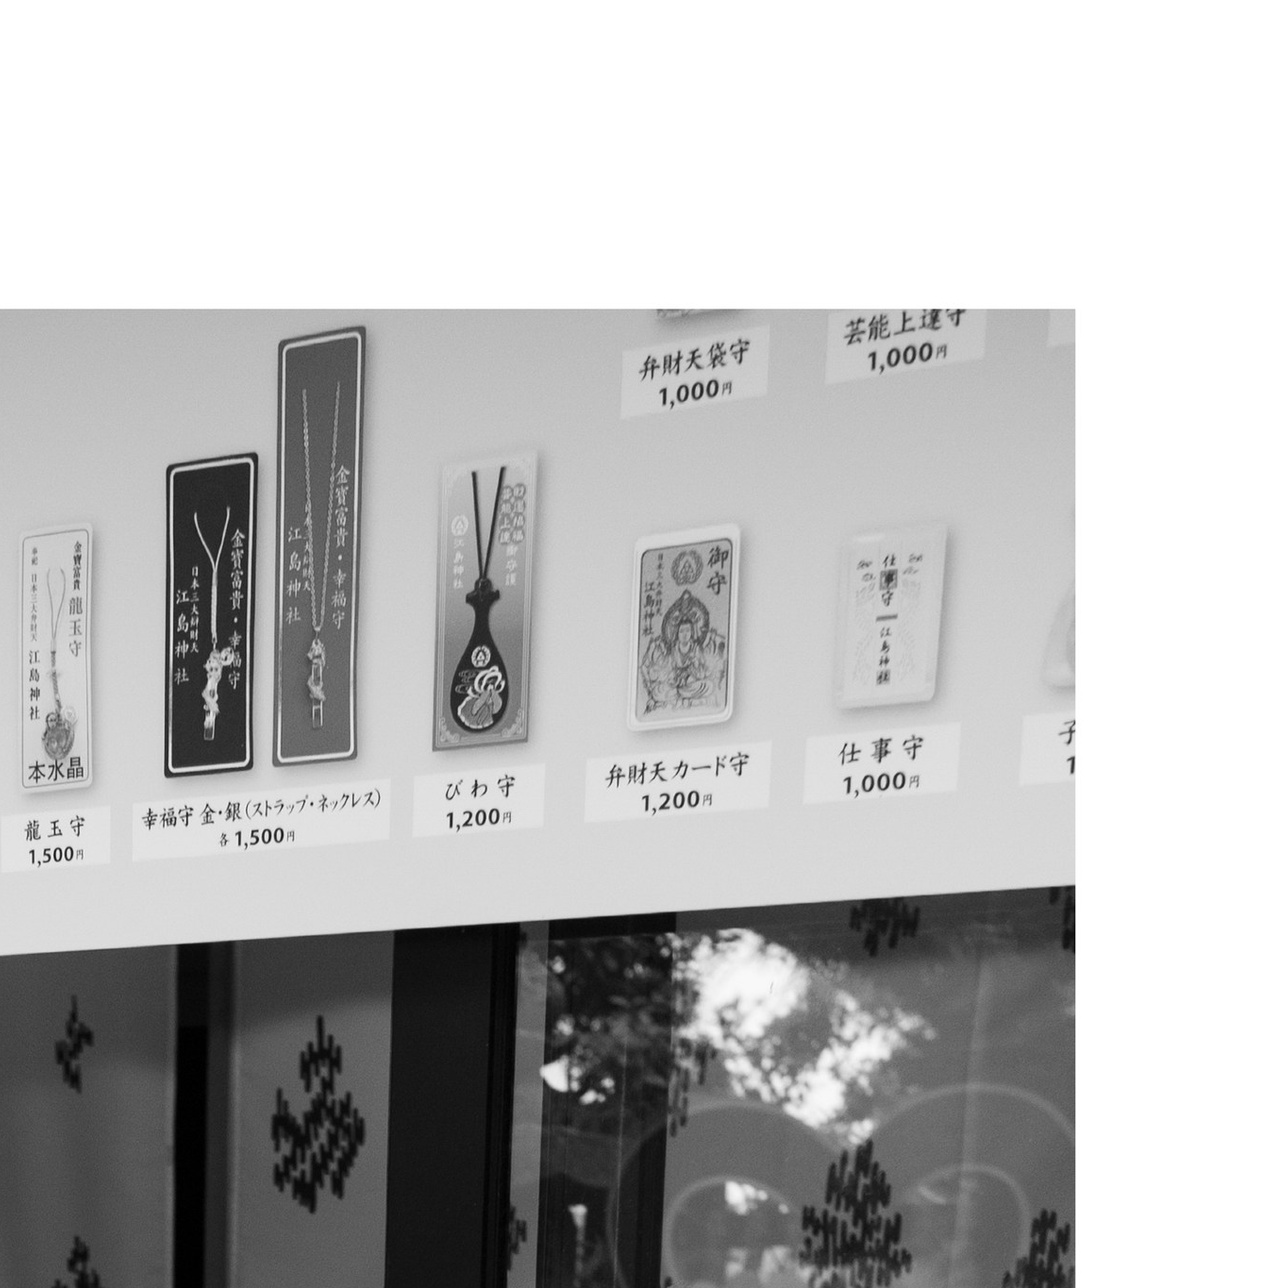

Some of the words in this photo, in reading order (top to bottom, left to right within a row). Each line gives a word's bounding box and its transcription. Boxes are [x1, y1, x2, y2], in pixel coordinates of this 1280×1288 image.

[639, 337, 750, 382] 弁財天袋守
[868, 342, 947, 374] 1,000円
[658, 378, 732, 410] 1,000円
[286, 527, 302, 625] 江島神社
[707, 546, 730, 596] 御守
[175, 590, 189, 685] 江島神社
[29, 650, 41, 722] 江島神社
[838, 734, 923, 766] 仕事守
[28, 756, 84, 784] 本水晶
[605, 751, 750, 788] 弁財天カード守
[842, 771, 920, 797] 1,000円
[445, 774, 515, 801] びわ守
[641, 789, 713, 816] 1,200円
[24, 815, 86, 842] 龍玉守
[446, 808, 513, 833] 1,200円
[27, 844, 84, 868] 1,500円
